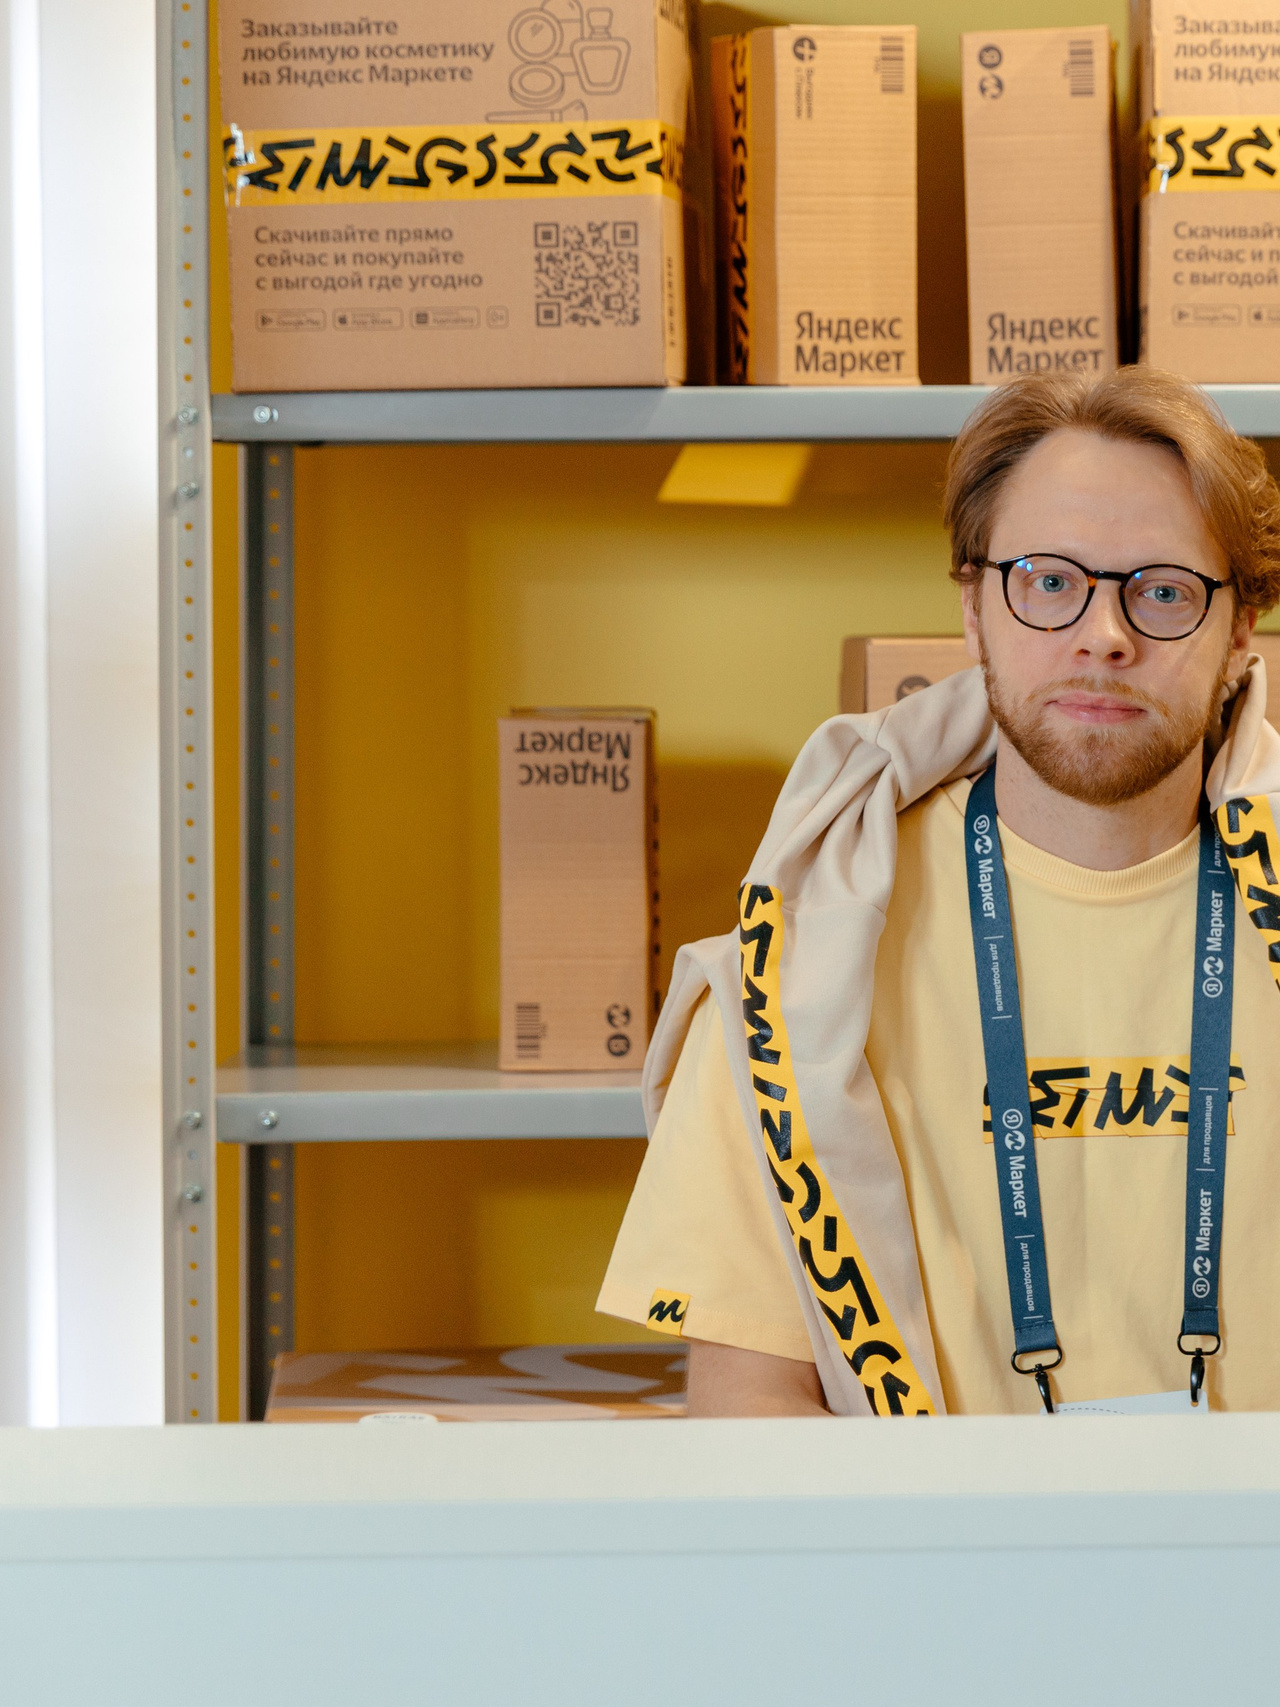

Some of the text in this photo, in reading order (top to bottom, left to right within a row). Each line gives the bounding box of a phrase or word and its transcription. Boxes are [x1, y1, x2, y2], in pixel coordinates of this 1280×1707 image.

[242, 18, 398, 38] Заказывайте
[241, 41, 494, 63] любимую косметику
[242, 62, 473, 88] на Яндекс Маркете
[1174, 66, 1202, 83] на
[255, 224, 454, 246] Скачивайте прямо
[255, 247, 464, 269] сейчас и покупайте
[1174, 245, 1245, 263] сейчас
[1251, 249, 1262, 262] и
[256, 271, 483, 292] с выгодой где угодно
[1174, 271, 1184, 286] с
[1190, 268, 1278, 288] выгодой
[795, 312, 903, 342] Яндекс
[987, 313, 1100, 342] Яндекс
[795, 346, 905, 378] Маркет
[515, 728, 632, 758] Маркет
[519, 762, 630, 792] Яндекс
[978, 858, 996, 919] Маркет
[1207, 890, 1223, 951] Маркет
[988, 943, 1004, 1012] для продавцов
[1202, 1095, 1212, 1164] для продавцов
[1009, 1155, 1028, 1218] Маркет
[1196, 1189, 1212, 1251] Маркет
[1019, 1242, 1035, 1312] для продавцов
